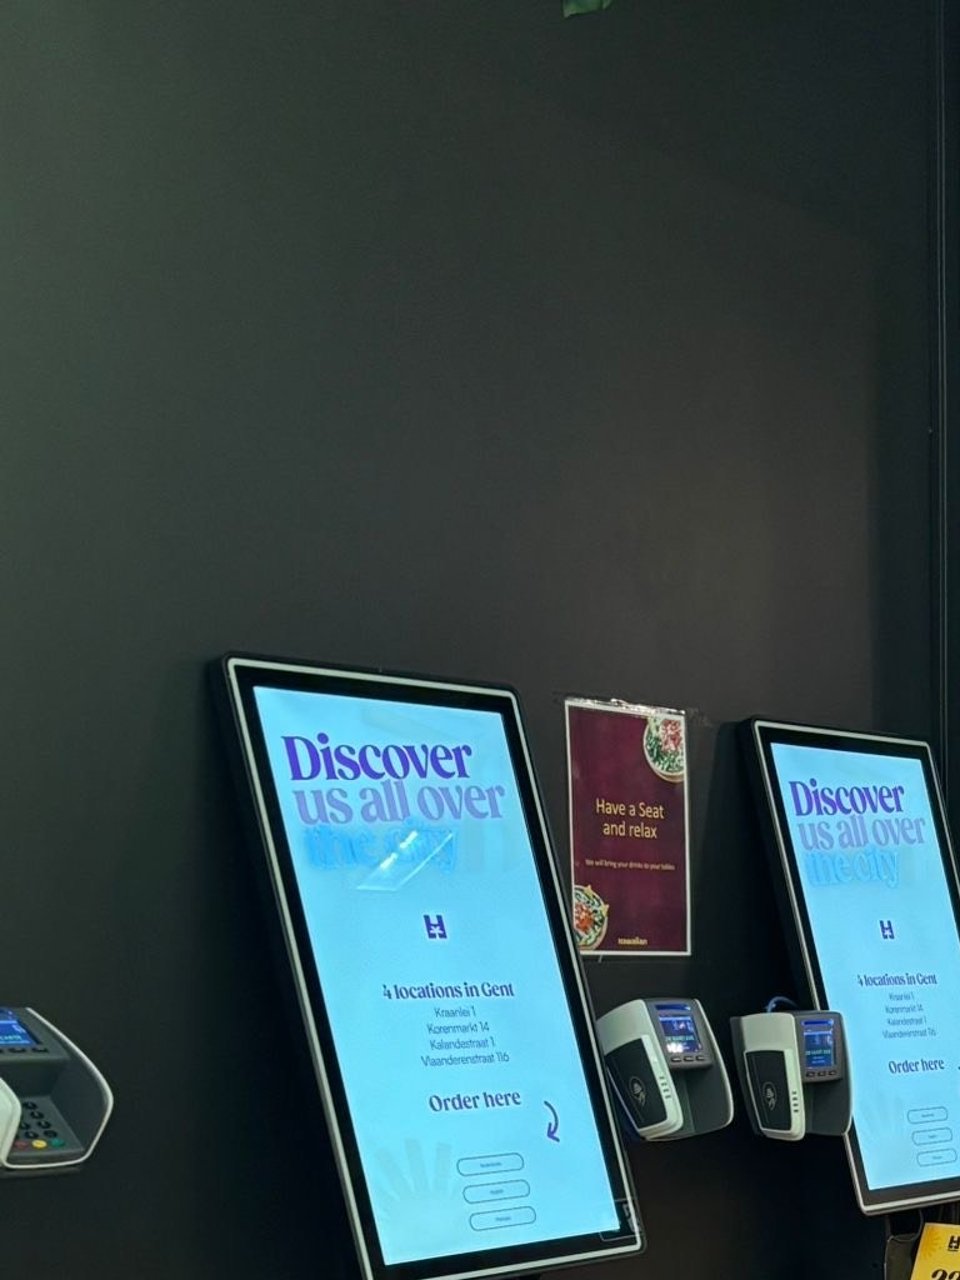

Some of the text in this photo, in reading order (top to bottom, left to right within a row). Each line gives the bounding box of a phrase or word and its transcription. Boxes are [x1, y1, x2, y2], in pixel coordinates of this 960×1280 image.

[281, 732, 472, 782] Discover
[293, 781, 506, 826] us all over
[789, 778, 904, 816] Discover
[596, 798, 664, 819] Have a Seat
[603, 821, 657, 839] and relax
[798, 815, 927, 851] us all over
[864, 974, 906, 987] locations
[907, 973, 916, 985] in
[916, 972, 938, 985] Gent
[383, 981, 515, 1000] 4 locations in Gent
[434, 1006, 477, 1018] Kraanlei 1
[427, 1021, 490, 1034] Korenmarkt 14
[490, 1036, 496, 1047] 1
[421, 1053, 495, 1066] Vlaanderenstraat
[888, 1057, 945, 1075] Order here
[429, 1089, 522, 1113] Order here
